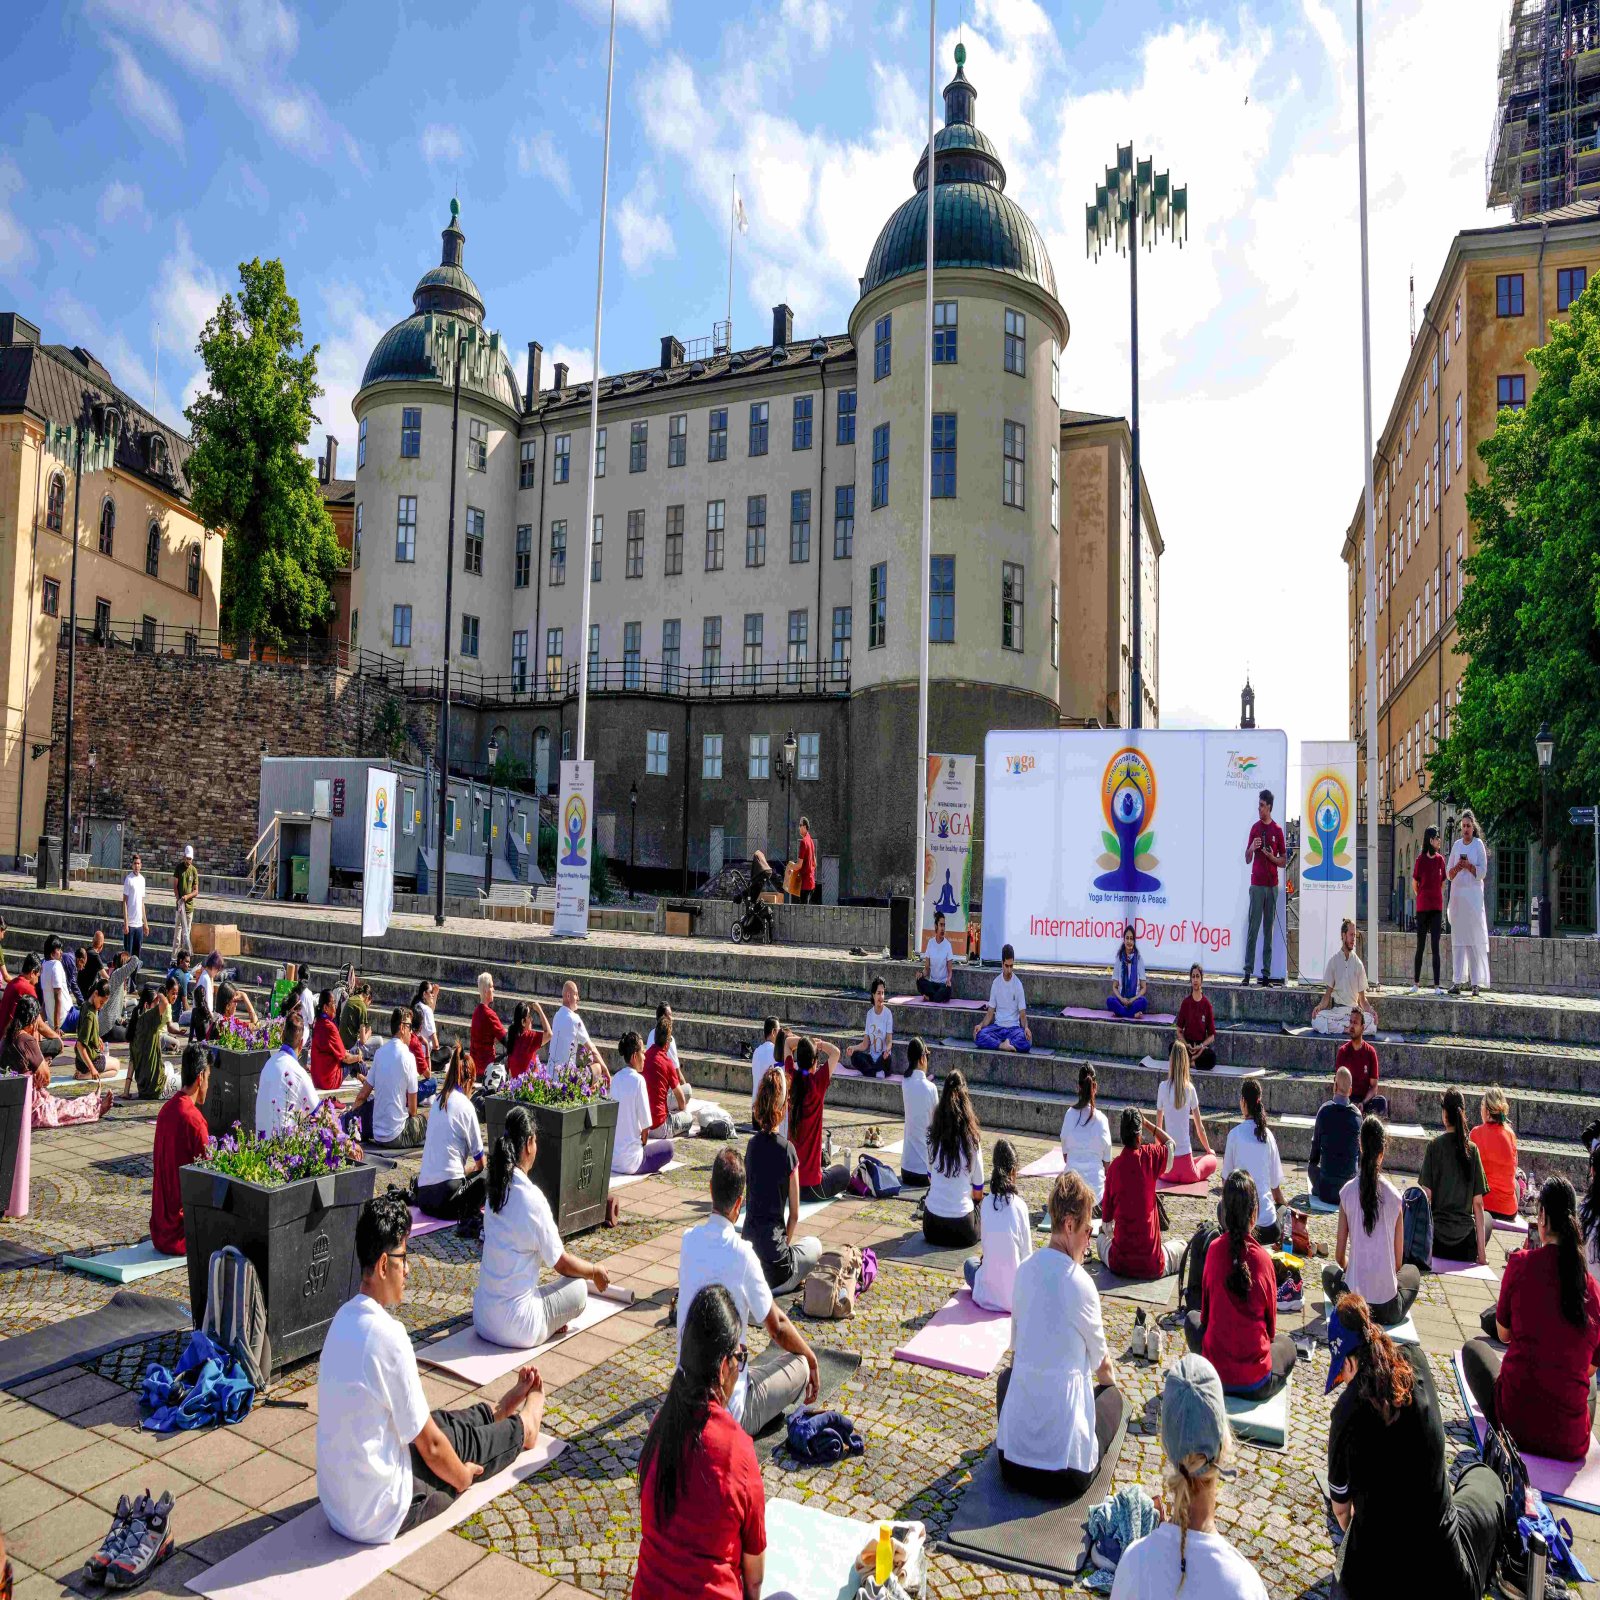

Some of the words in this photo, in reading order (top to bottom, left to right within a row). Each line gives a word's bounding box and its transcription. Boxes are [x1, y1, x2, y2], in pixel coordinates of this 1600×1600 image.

[1088, 892, 1103, 904] Yoga
[1104, 893, 1112, 901] for
[1113, 893, 1141, 904] Harmony
[1141, 894, 1147, 903] &
[1148, 894, 1167, 904] Peace
[1134, 917, 1165, 948] Day
[1170, 920, 1187, 942] of
[1191, 920, 1231, 952] Yoga
